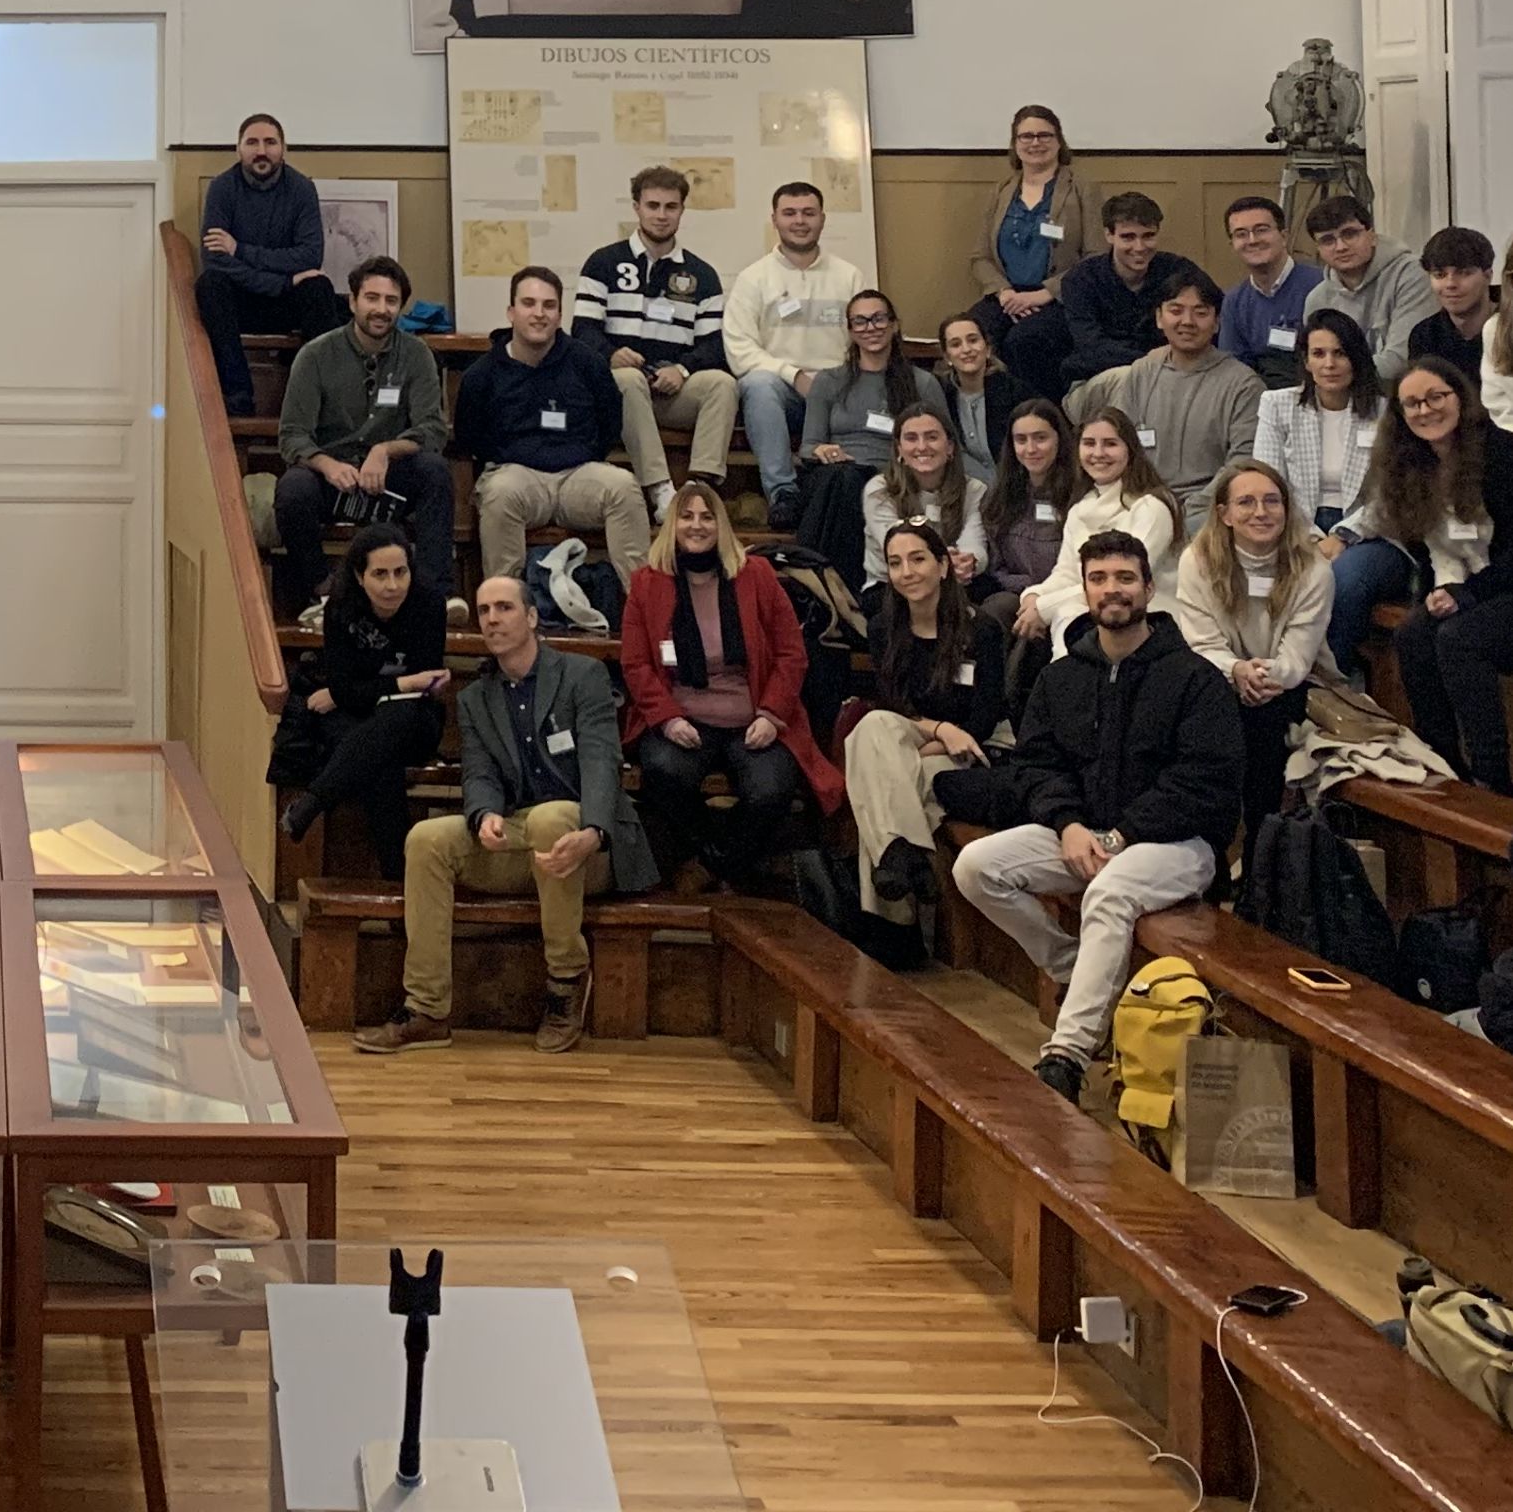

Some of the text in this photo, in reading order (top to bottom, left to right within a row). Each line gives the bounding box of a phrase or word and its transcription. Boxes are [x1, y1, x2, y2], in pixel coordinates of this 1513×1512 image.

[540, 44, 771, 64] DIBUJOS CIENTÍFICOS
[616, 262, 641, 292] 3
